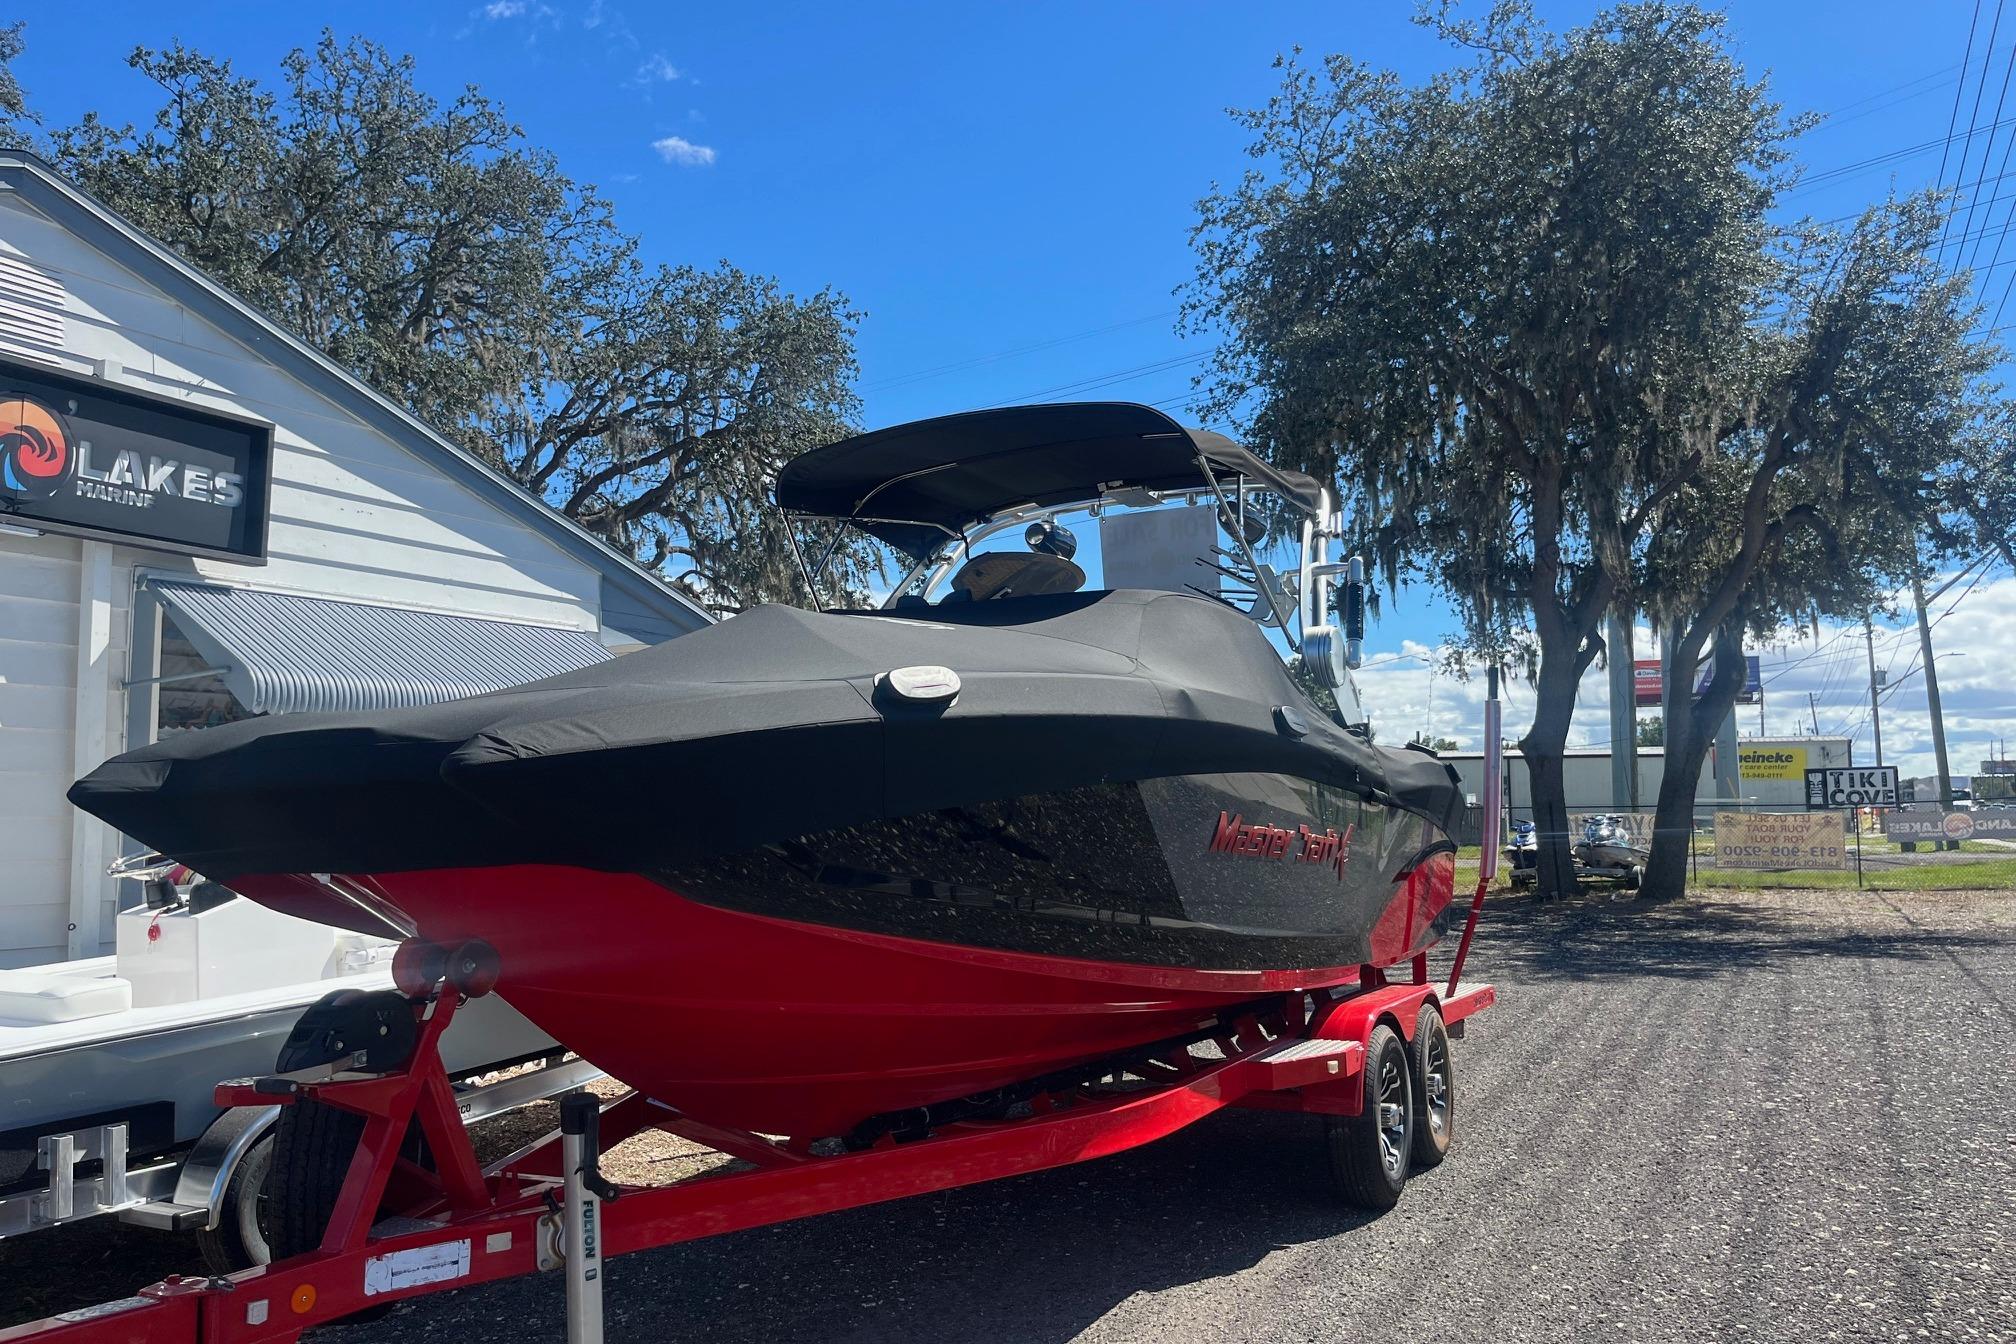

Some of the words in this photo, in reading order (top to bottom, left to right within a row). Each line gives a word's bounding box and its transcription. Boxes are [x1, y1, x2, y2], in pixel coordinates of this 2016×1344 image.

[77, 440, 243, 507] LAKES
[76, 480, 155, 508] MARINE
[1829, 771, 1888, 788] TIKI
[1829, 789, 1894, 806] COVE
[583, 1200, 596, 1260] FULTON
